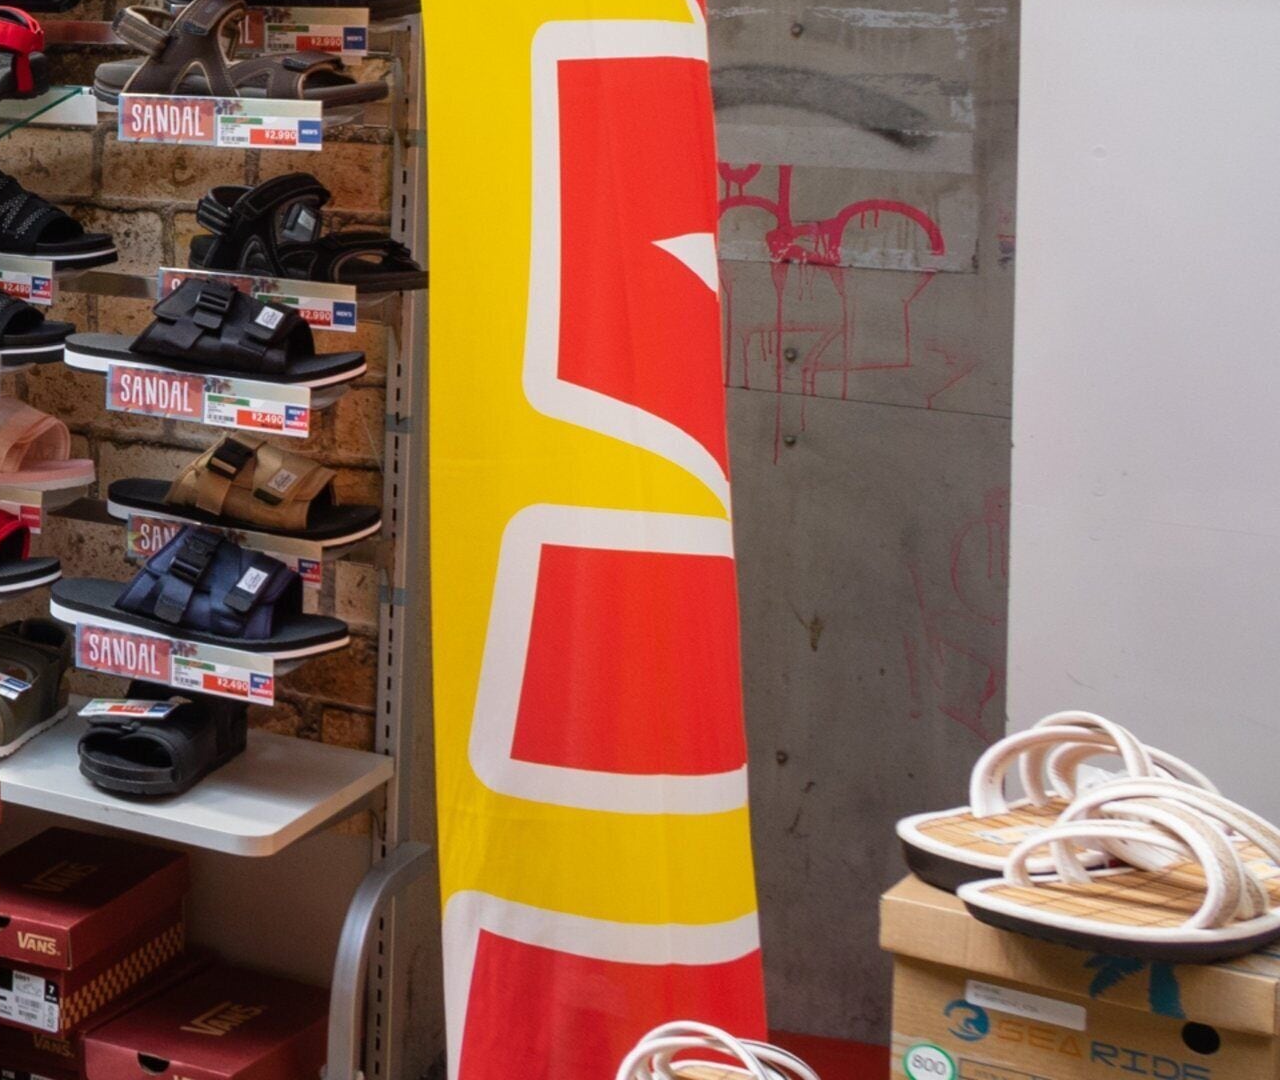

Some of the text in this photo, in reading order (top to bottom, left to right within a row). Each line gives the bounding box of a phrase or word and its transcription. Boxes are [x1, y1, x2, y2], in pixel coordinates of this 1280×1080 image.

[131, 103, 297, 142] SANDAL ¥2,990
[119, 373, 194, 413] SANDAL
[89, 633, 161, 676] SANDAL
[16, 930, 57, 955] VANS
[911, 1054, 947, 1077] 800
[996, 1019, 1211, 1080] SEA RIDE
